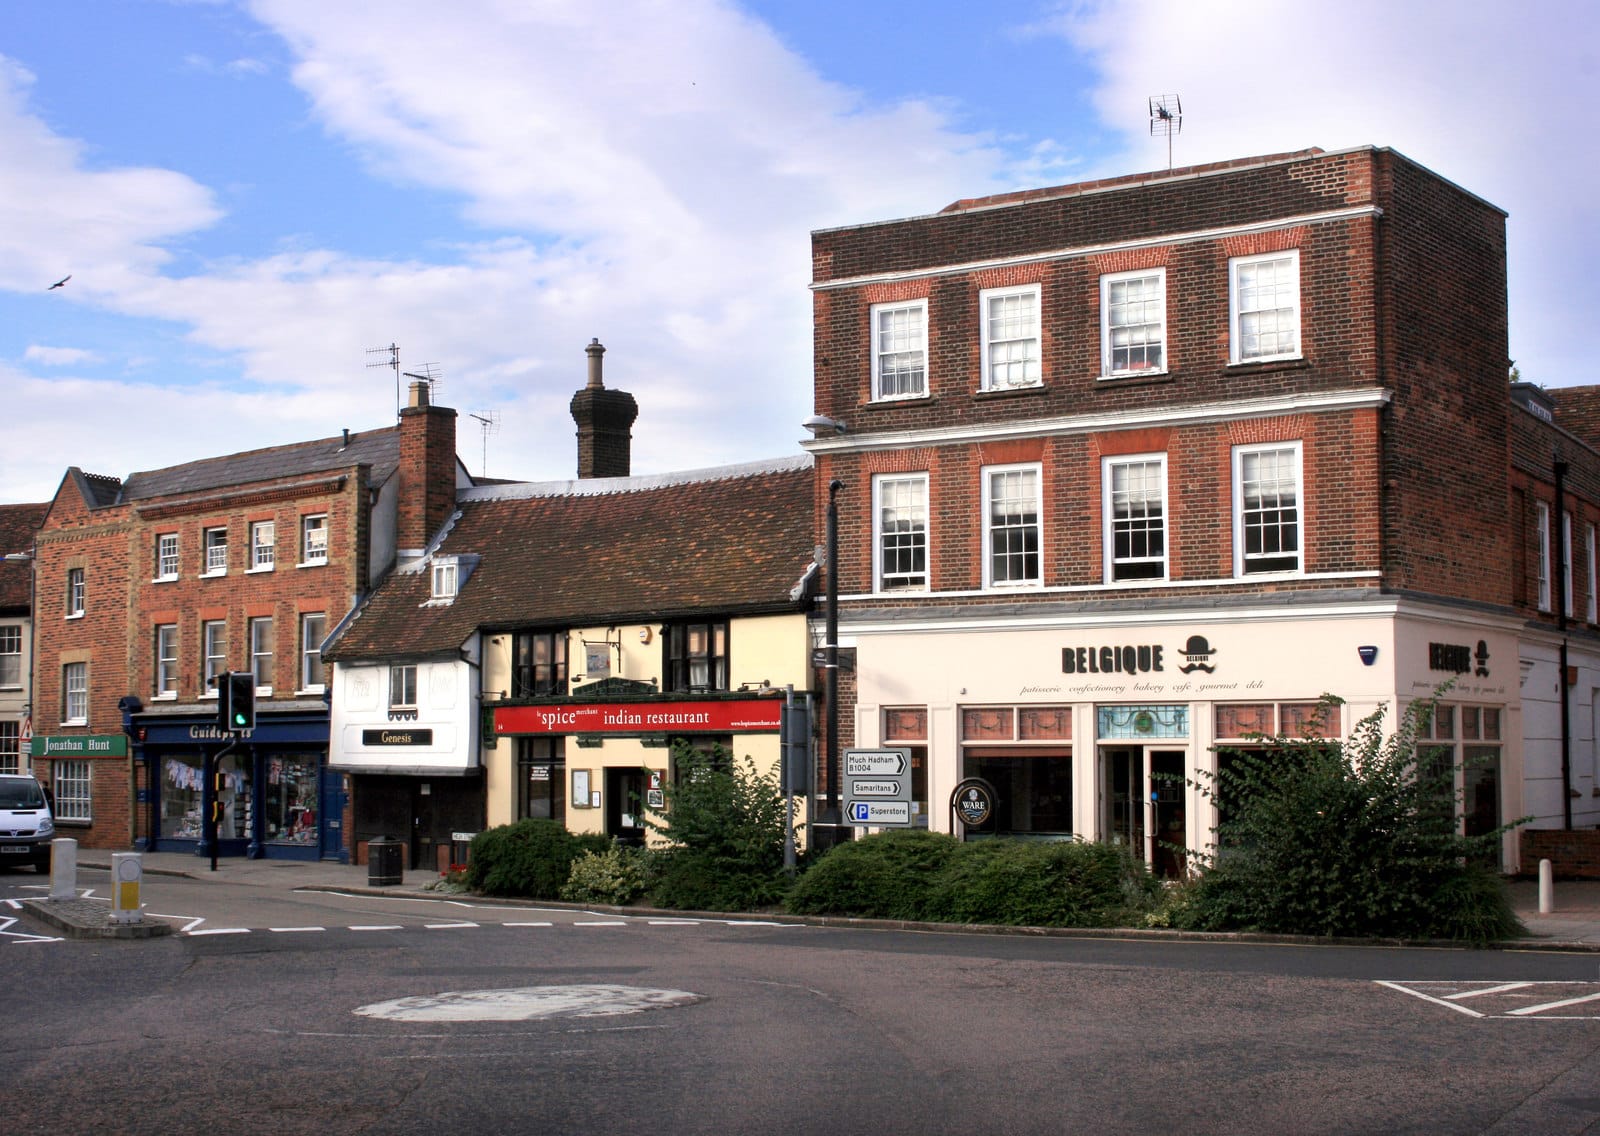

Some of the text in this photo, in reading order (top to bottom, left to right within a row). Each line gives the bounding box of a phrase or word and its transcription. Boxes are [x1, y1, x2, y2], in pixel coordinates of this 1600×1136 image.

[1061, 644, 1164, 675] BELGIQUE
[1019, 685, 1061, 696] patisserie
[1068, 682, 1126, 695] confectionery
[1133, 682, 1165, 694] bakery
[1195, 681, 1239, 693] gourmet
[1246, 679, 1264, 690] deli
[541, 707, 576, 730] spice
[603, 708, 642, 725] indian
[647, 711, 710, 724] restaurant
[381, 730, 412, 744] Genesis
[43, 737, 83, 756] Jonathan
[88, 739, 110, 751] Hunt
[849, 756, 894, 764] Much Hadham
[849, 764, 871, 772] B1004
[855, 784, 892, 792] Samaritans
[962, 801, 985, 810] WARE
[870, 807, 907, 816] Superstore
